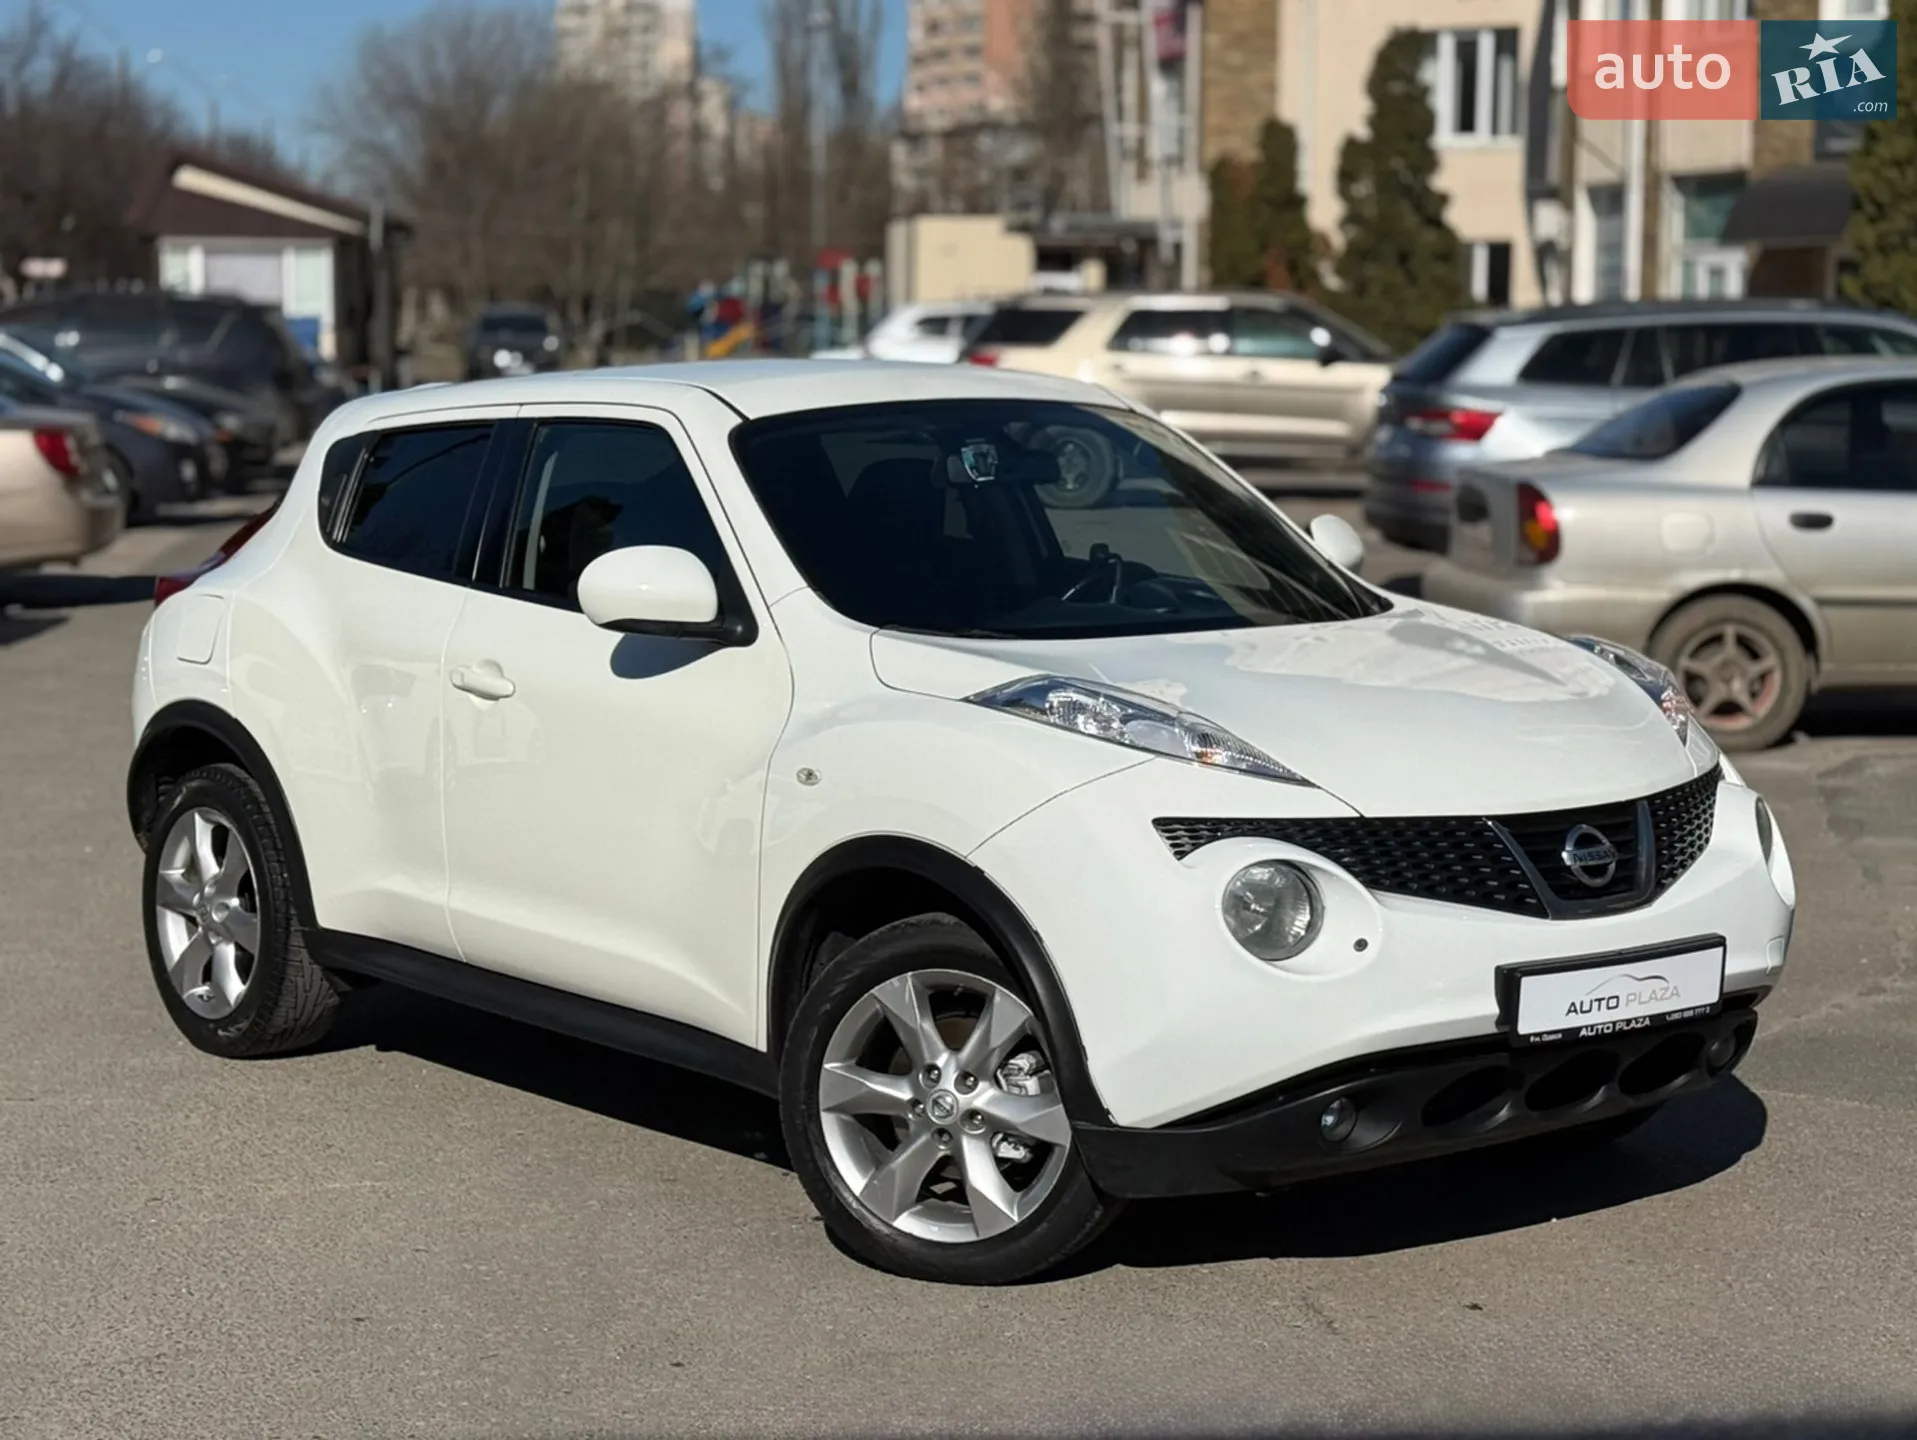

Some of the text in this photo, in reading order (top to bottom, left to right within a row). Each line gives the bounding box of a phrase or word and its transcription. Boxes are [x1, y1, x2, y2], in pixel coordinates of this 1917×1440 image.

[1565, 985, 1681, 1017] AUTO PLAZA
[1579, 1022, 1614, 1038] AUTO
[1615, 1016, 1651, 1032] PLAZA
